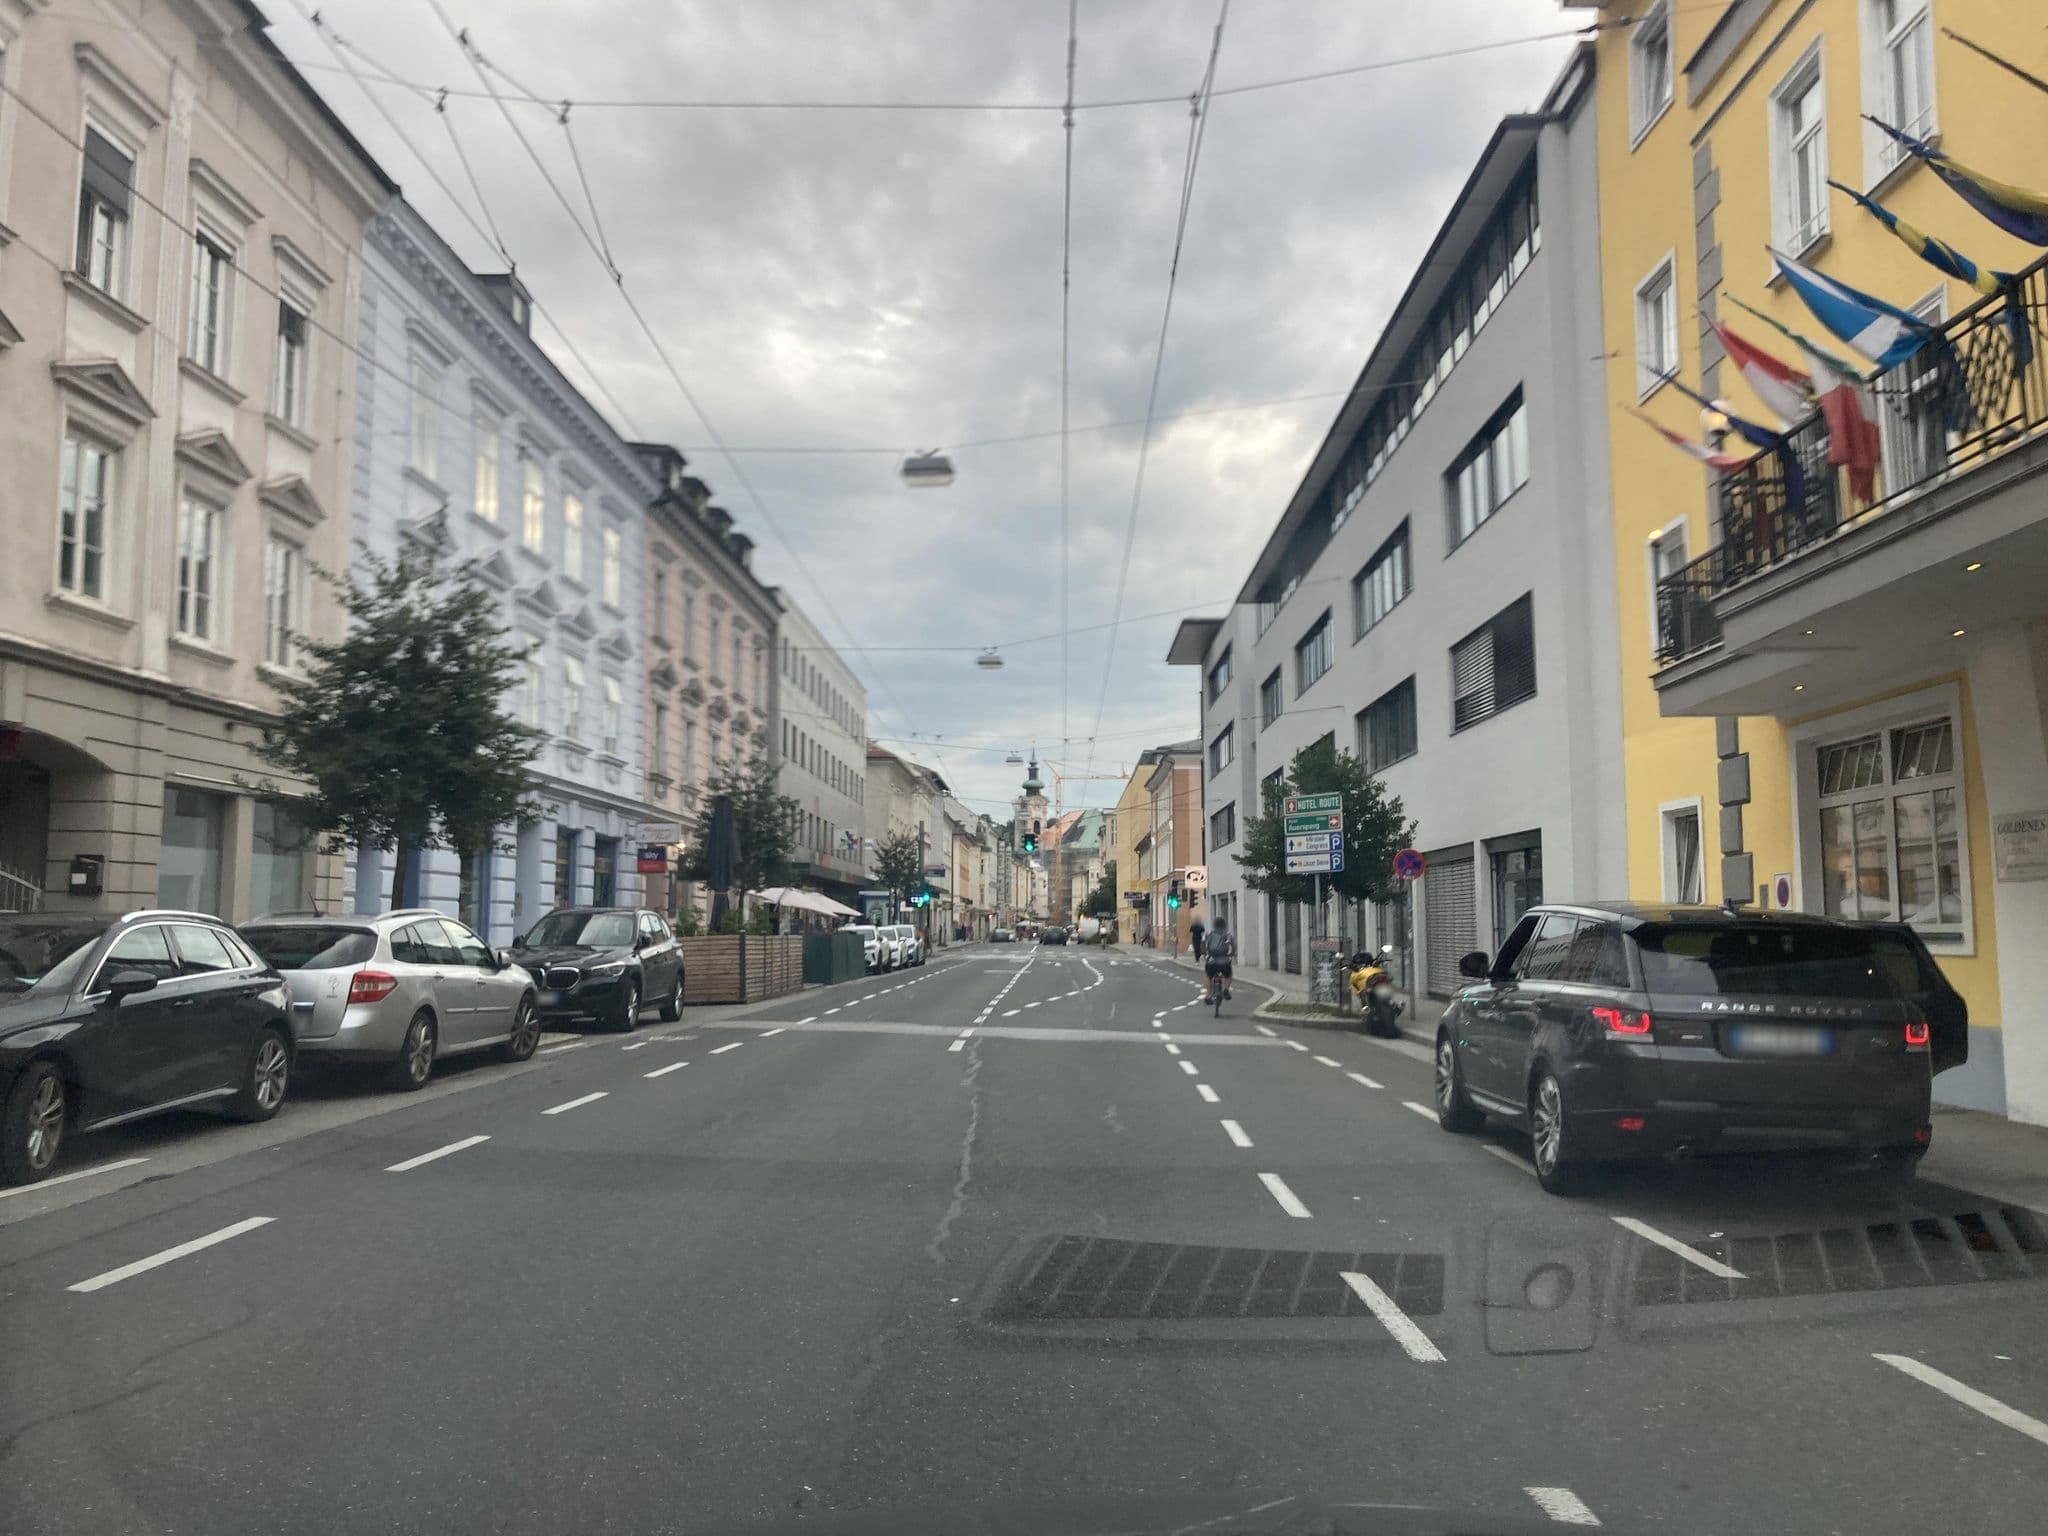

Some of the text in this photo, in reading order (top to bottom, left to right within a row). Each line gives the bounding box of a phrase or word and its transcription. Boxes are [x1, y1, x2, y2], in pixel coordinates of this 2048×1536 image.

[1297, 796, 1340, 809] HOTEL ROUTE
[1332, 838, 1340, 849] P
[1333, 857, 1340, 869] P
[1701, 1001, 1863, 1017] RANGE ROVER
